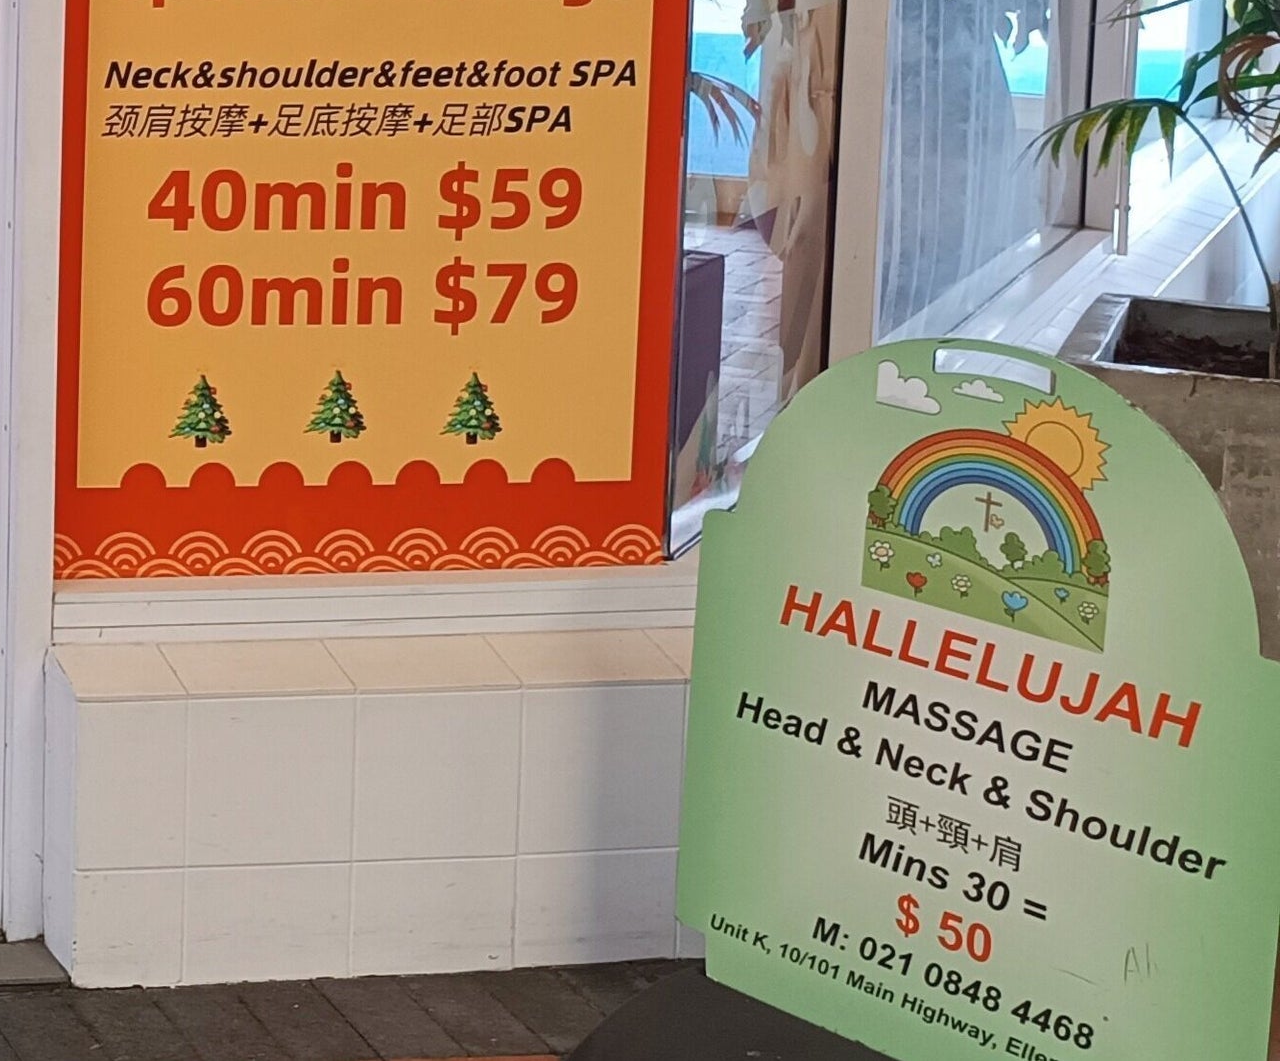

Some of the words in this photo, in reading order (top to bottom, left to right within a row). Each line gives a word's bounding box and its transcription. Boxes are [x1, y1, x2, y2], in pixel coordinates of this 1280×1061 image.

[104, 59, 561, 89] Neck&shoulder&feet&foot
[569, 59, 637, 87] SPA
[147, 162, 407, 231] 40min
[438, 161, 583, 241] $59
[146, 257, 402, 327] 60min
[434, 257, 579, 335] $79
[779, 585, 1202, 748] HALLELUJAH
[862, 681, 1074, 774] MASSAGE
[736, 692, 828, 746] Head
[837, 726, 863, 758] &
[874, 738, 972, 796] Neck
[984, 776, 1012, 810] &
[1025, 790, 1226, 882] Shoulder
[858, 832, 949, 891] Mins
[963, 872, 1010, 912] 30
[1023, 898, 1049, 922] =
[895, 894, 921, 938] $
[938, 910, 994, 963] 50
[709, 914, 750, 944] Unit
[752, 930, 772, 956] K,
[778, 940, 842, 980] 10/101
[846, 972, 896, 1004] Main
[900, 990, 999, 1050] Highway,
[1005, 1037, 1059, 1061] Elle
[812, 916, 850, 952] M:
[858, 934, 914, 976] 021
[924, 961, 1002, 1014] 0848
[1010, 1000, 1096, 1050] 4468
